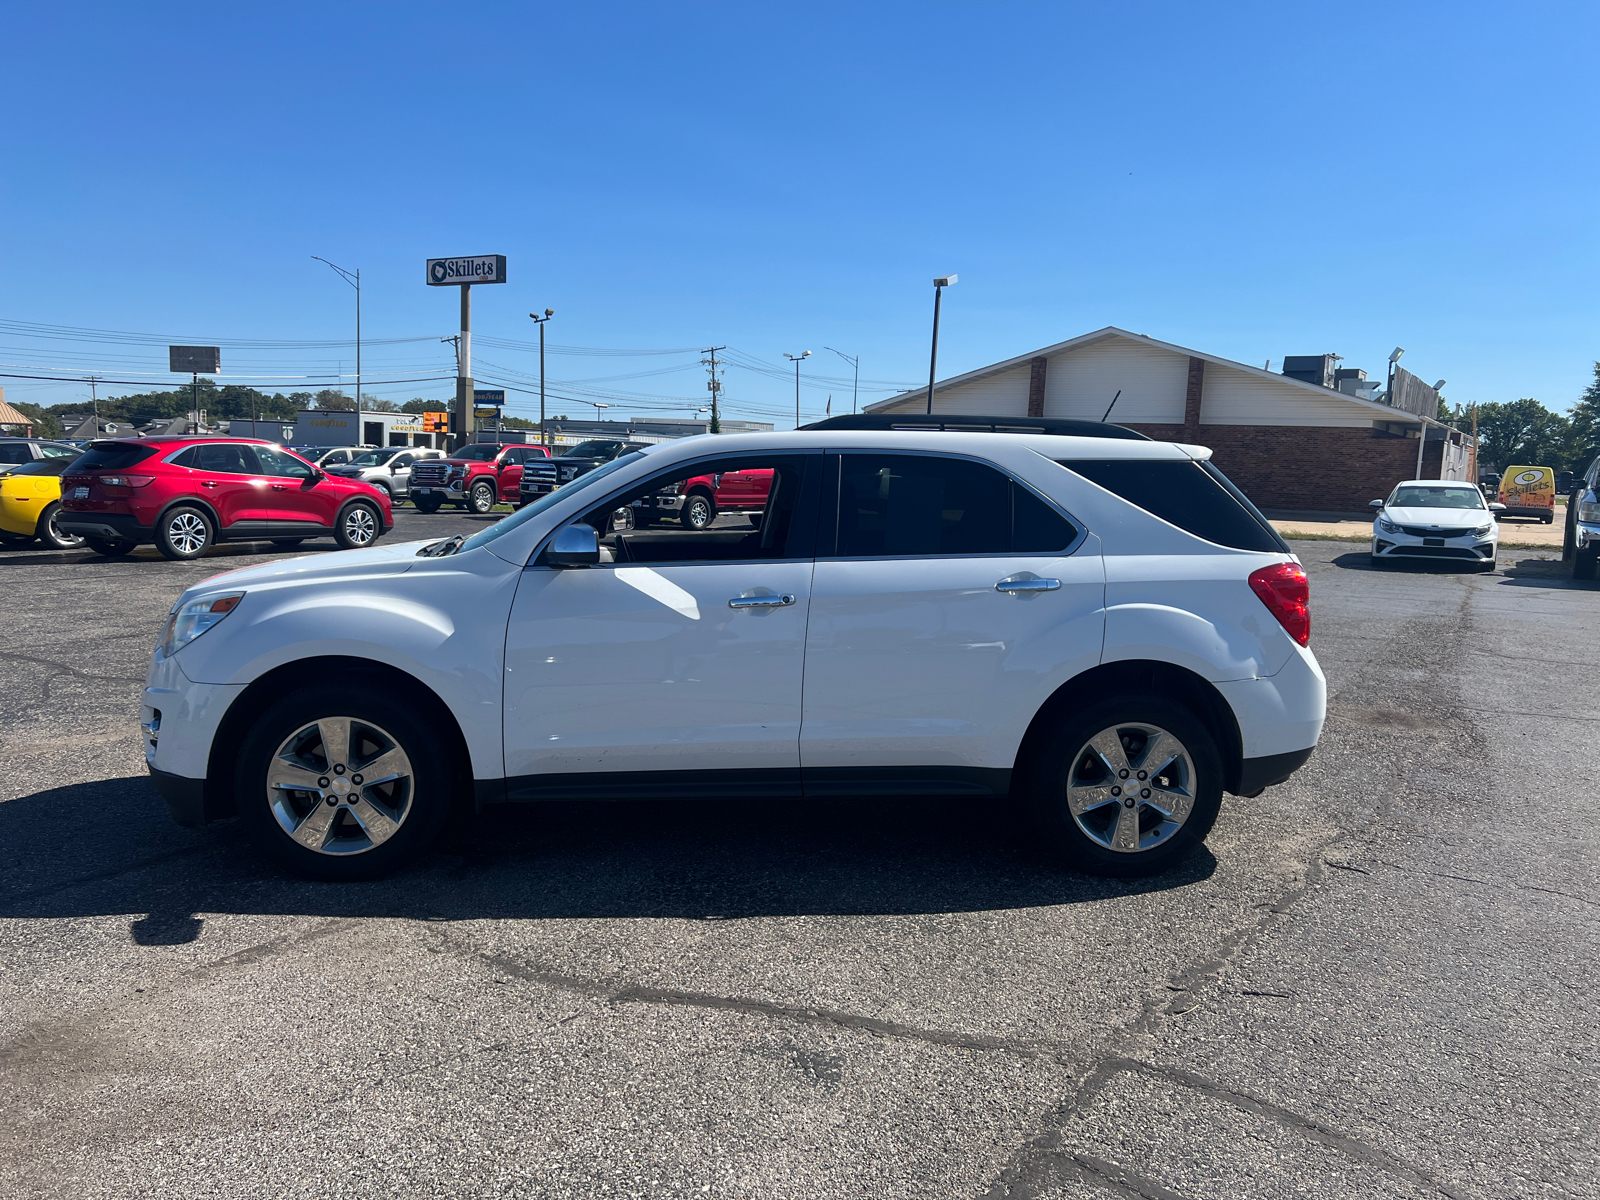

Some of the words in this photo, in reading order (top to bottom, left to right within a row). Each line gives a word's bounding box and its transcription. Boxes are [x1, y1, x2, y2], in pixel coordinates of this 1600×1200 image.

[447, 259, 494, 277] Skillets
[473, 392, 503, 401] OODYEAR
[309, 419, 348, 428] GOODYEAR
[1508, 482, 1549, 496] Skillets
